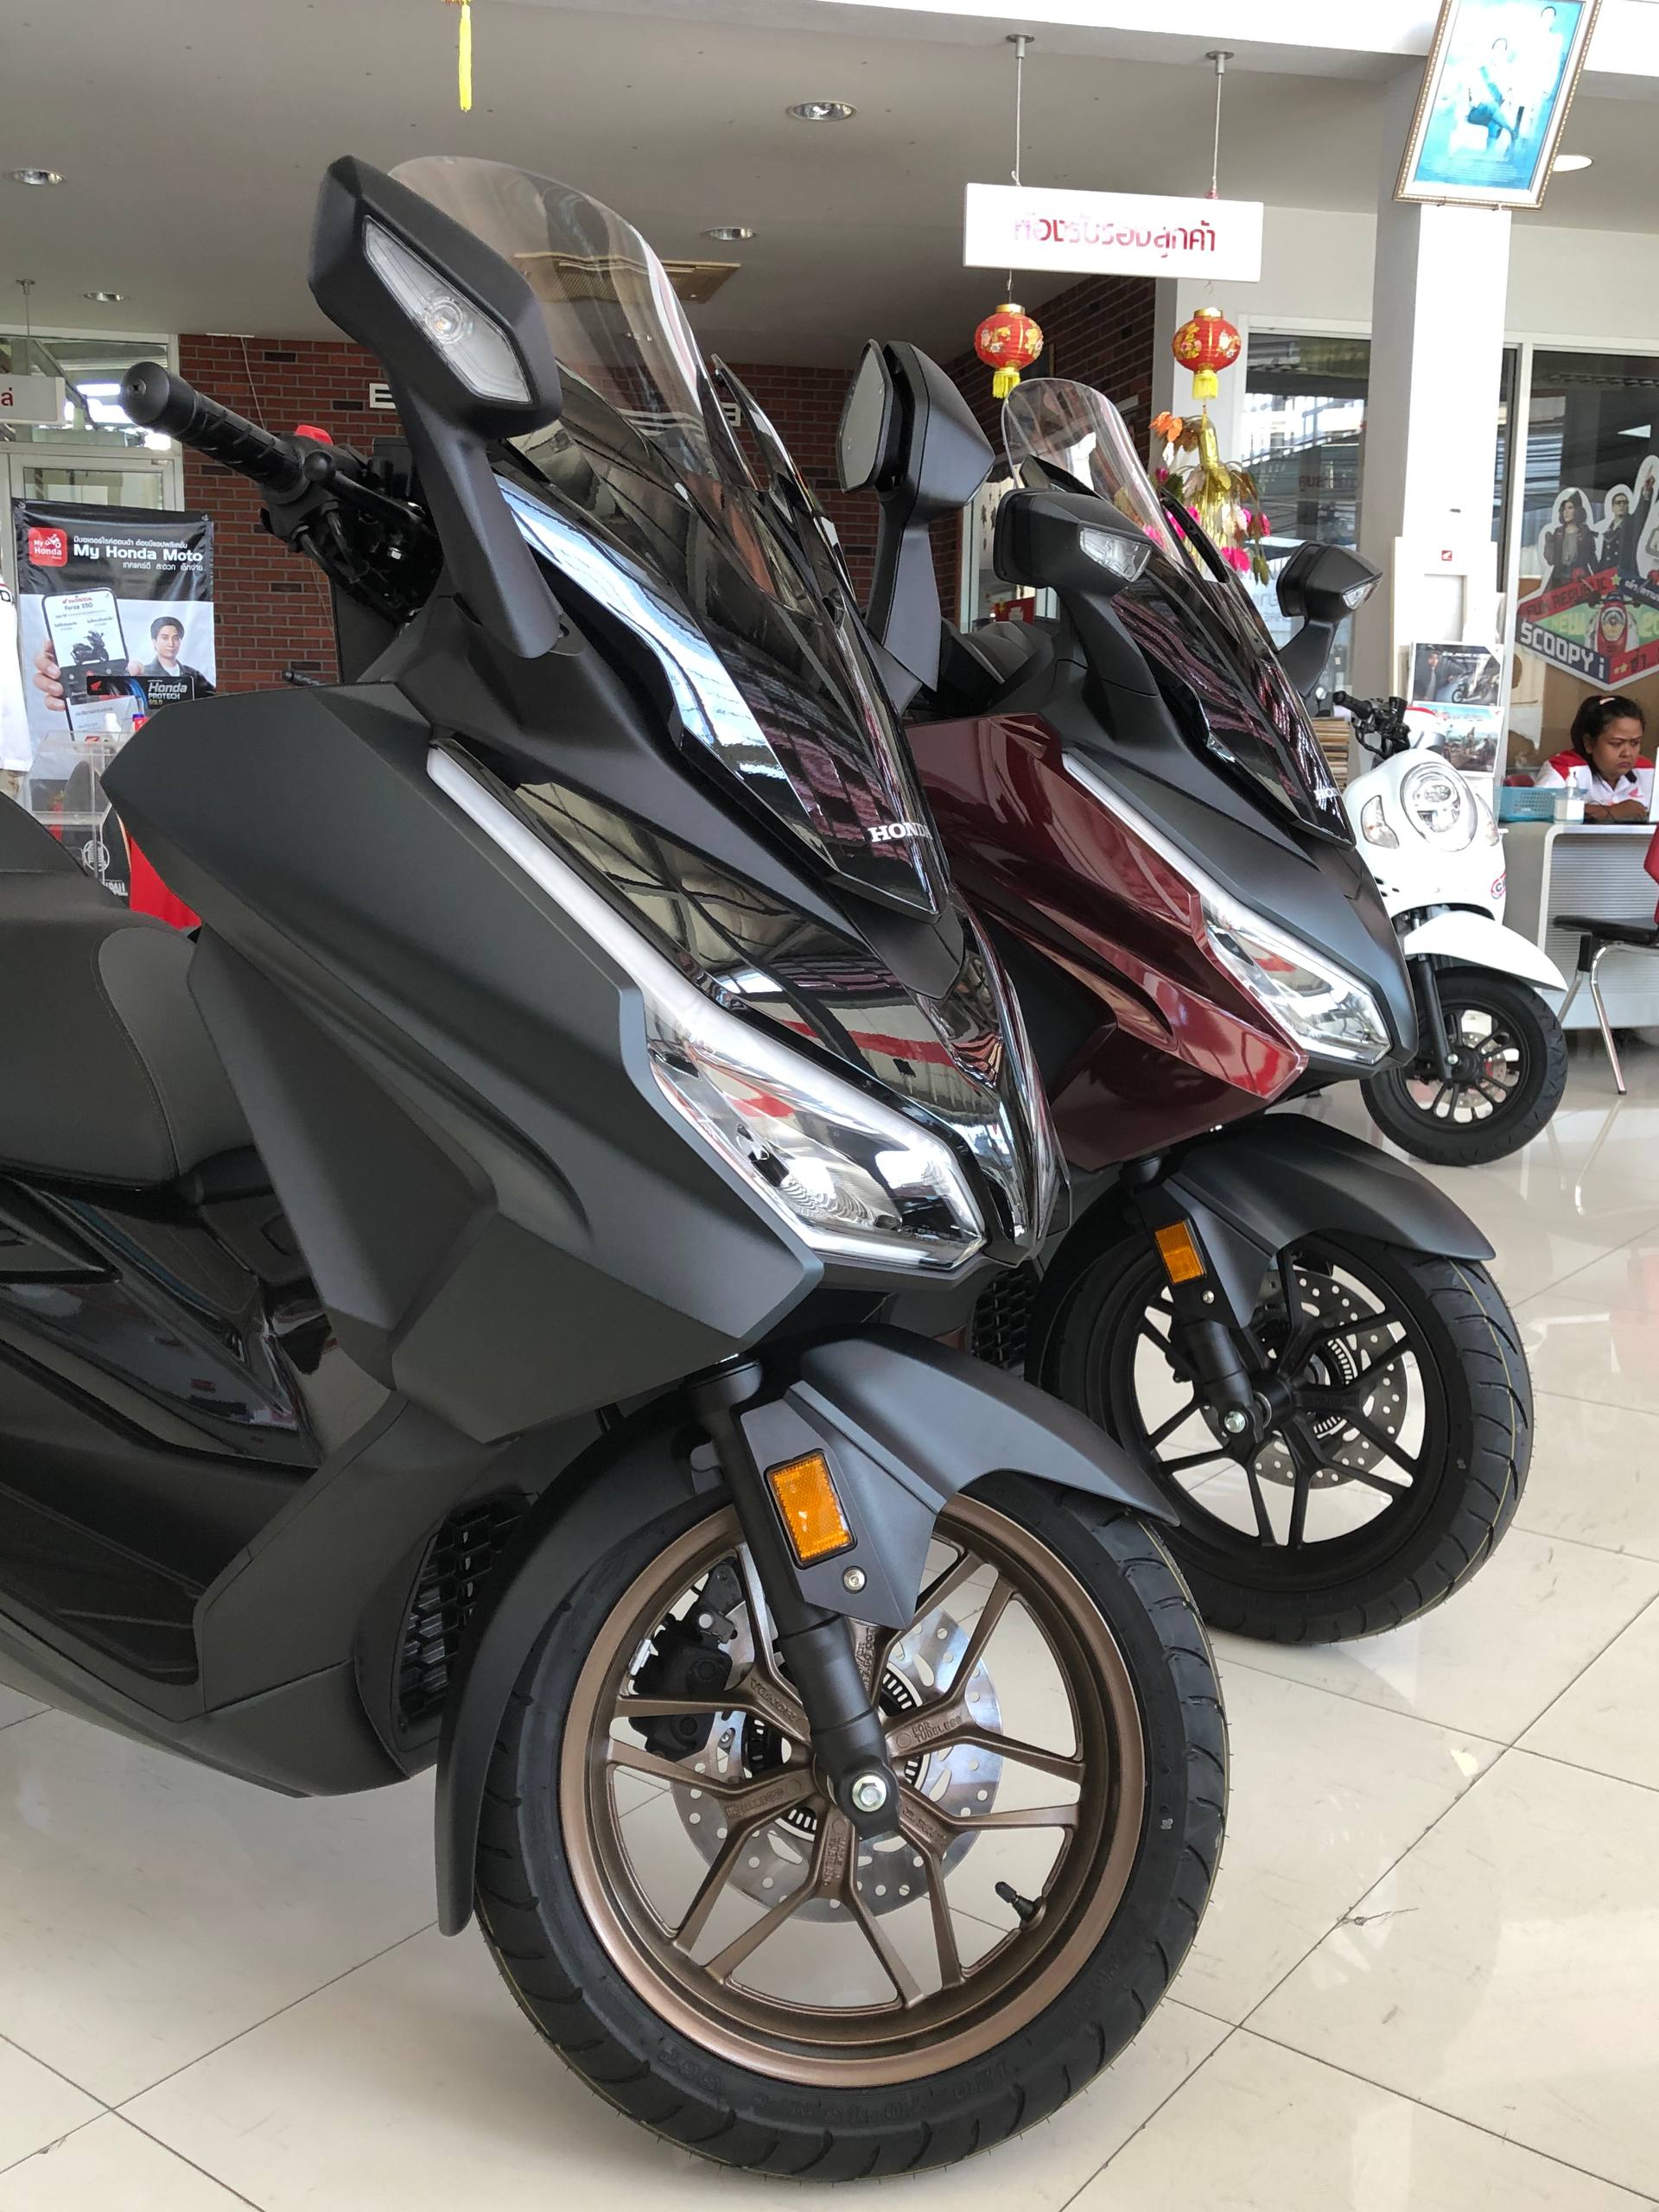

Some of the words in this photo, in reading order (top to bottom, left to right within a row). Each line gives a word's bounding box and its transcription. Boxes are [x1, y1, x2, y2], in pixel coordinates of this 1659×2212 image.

[34, 547, 62, 556] Honda
[73, 543, 99, 560] My
[105, 545, 157, 561] Honda
[162, 548, 203, 562] Moto
[1520, 620, 1594, 672] SCOOPY
[148, 682, 188, 693] Honda
[868, 822, 933, 842] HONDA
